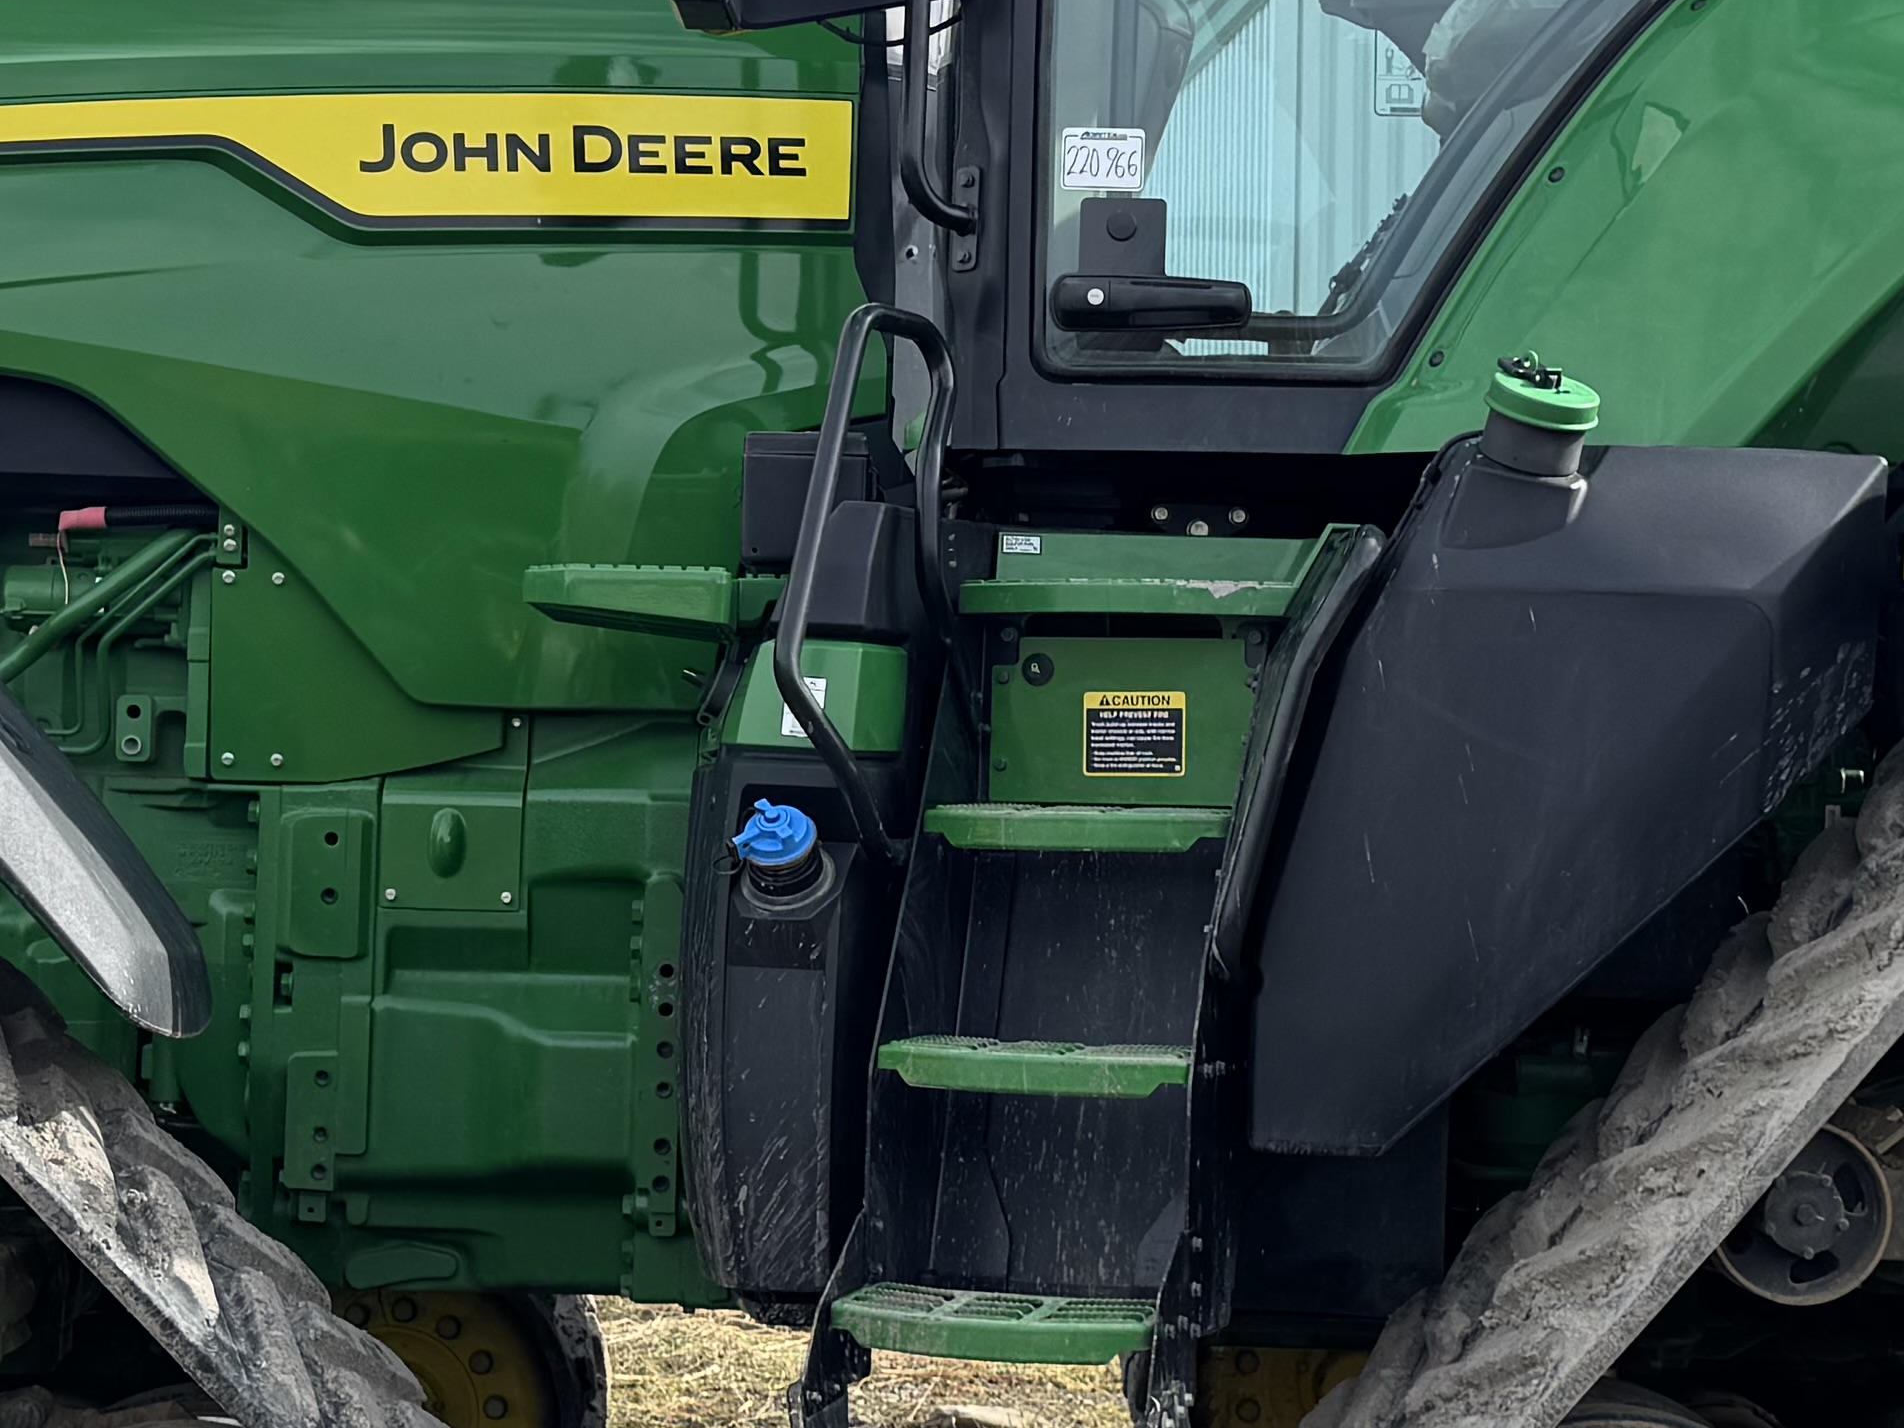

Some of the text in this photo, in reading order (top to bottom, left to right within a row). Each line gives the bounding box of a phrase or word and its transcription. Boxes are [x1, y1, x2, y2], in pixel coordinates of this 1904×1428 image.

[359, 123, 807, 176] JOHN DEERE
[1112, 694, 1171, 707] CAUTION
